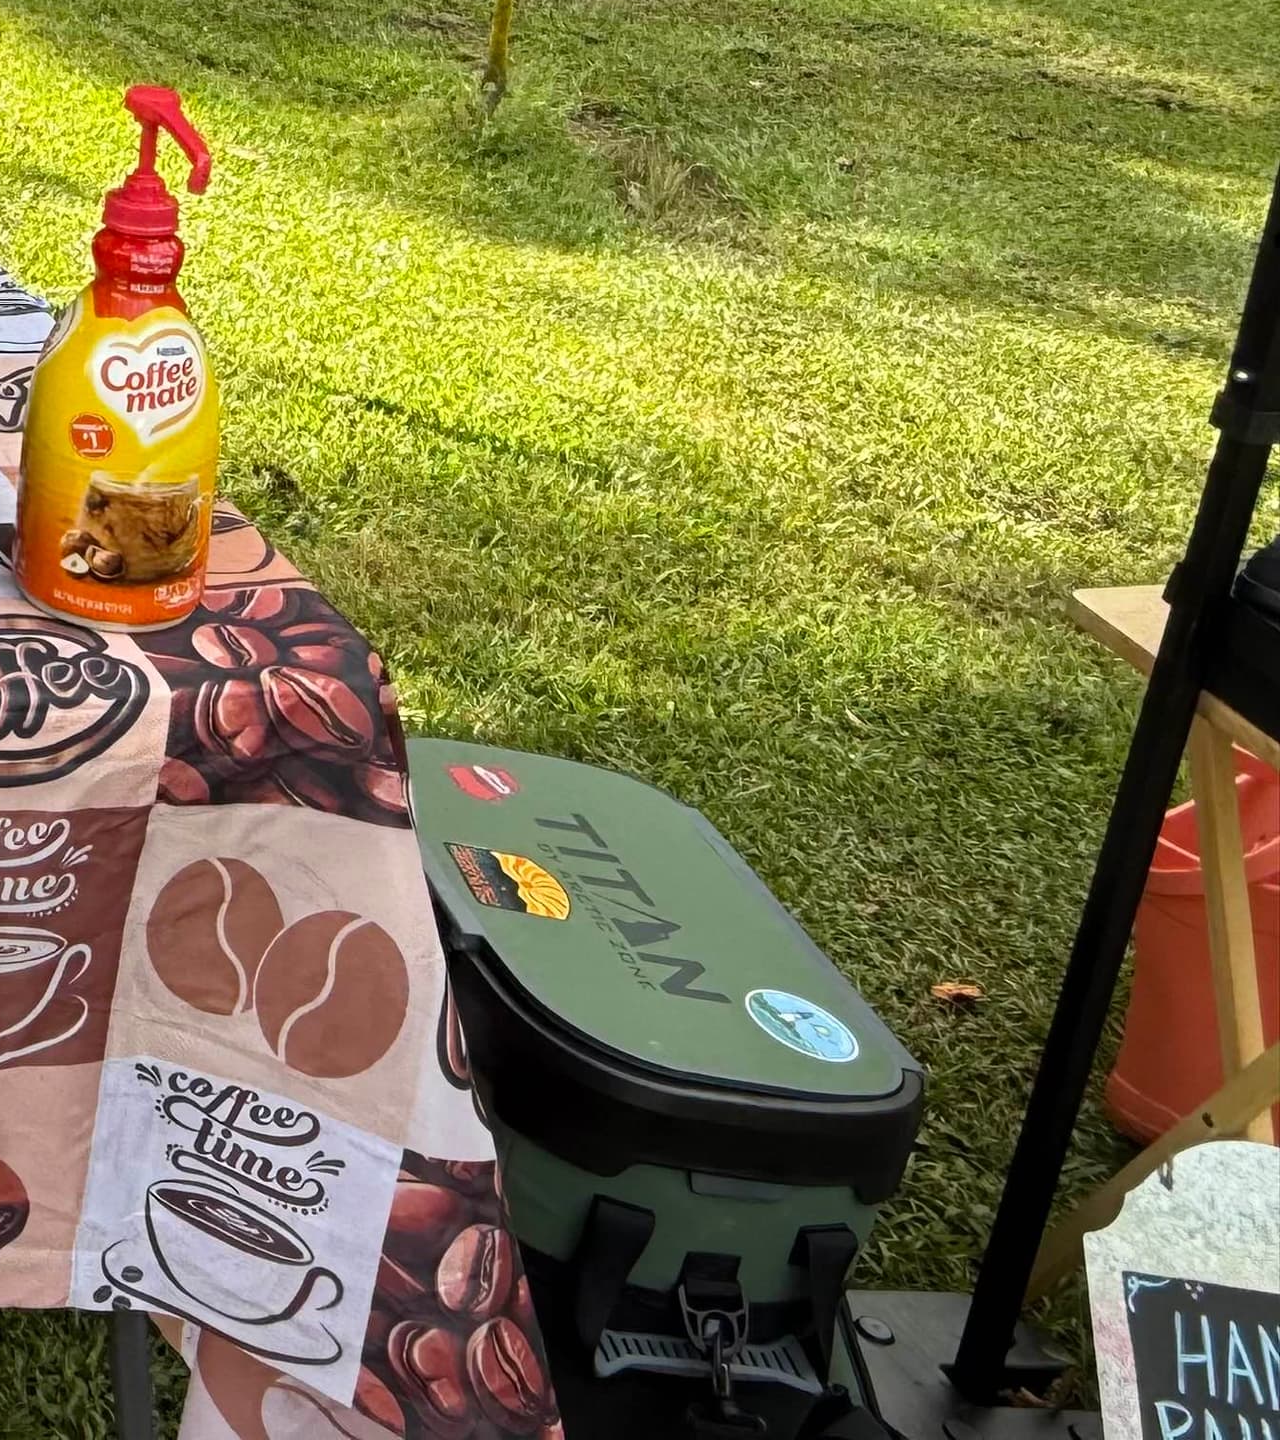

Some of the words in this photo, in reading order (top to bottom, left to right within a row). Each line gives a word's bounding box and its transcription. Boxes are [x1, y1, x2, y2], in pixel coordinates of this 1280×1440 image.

[100, 355, 194, 392] Coffee
[126, 374, 197, 413] mate
[534, 812, 732, 1004] TITAN
[608, 938, 657, 992] ZONE
[168, 1070, 322, 1148] coffee
[192, 1114, 327, 1202] time
